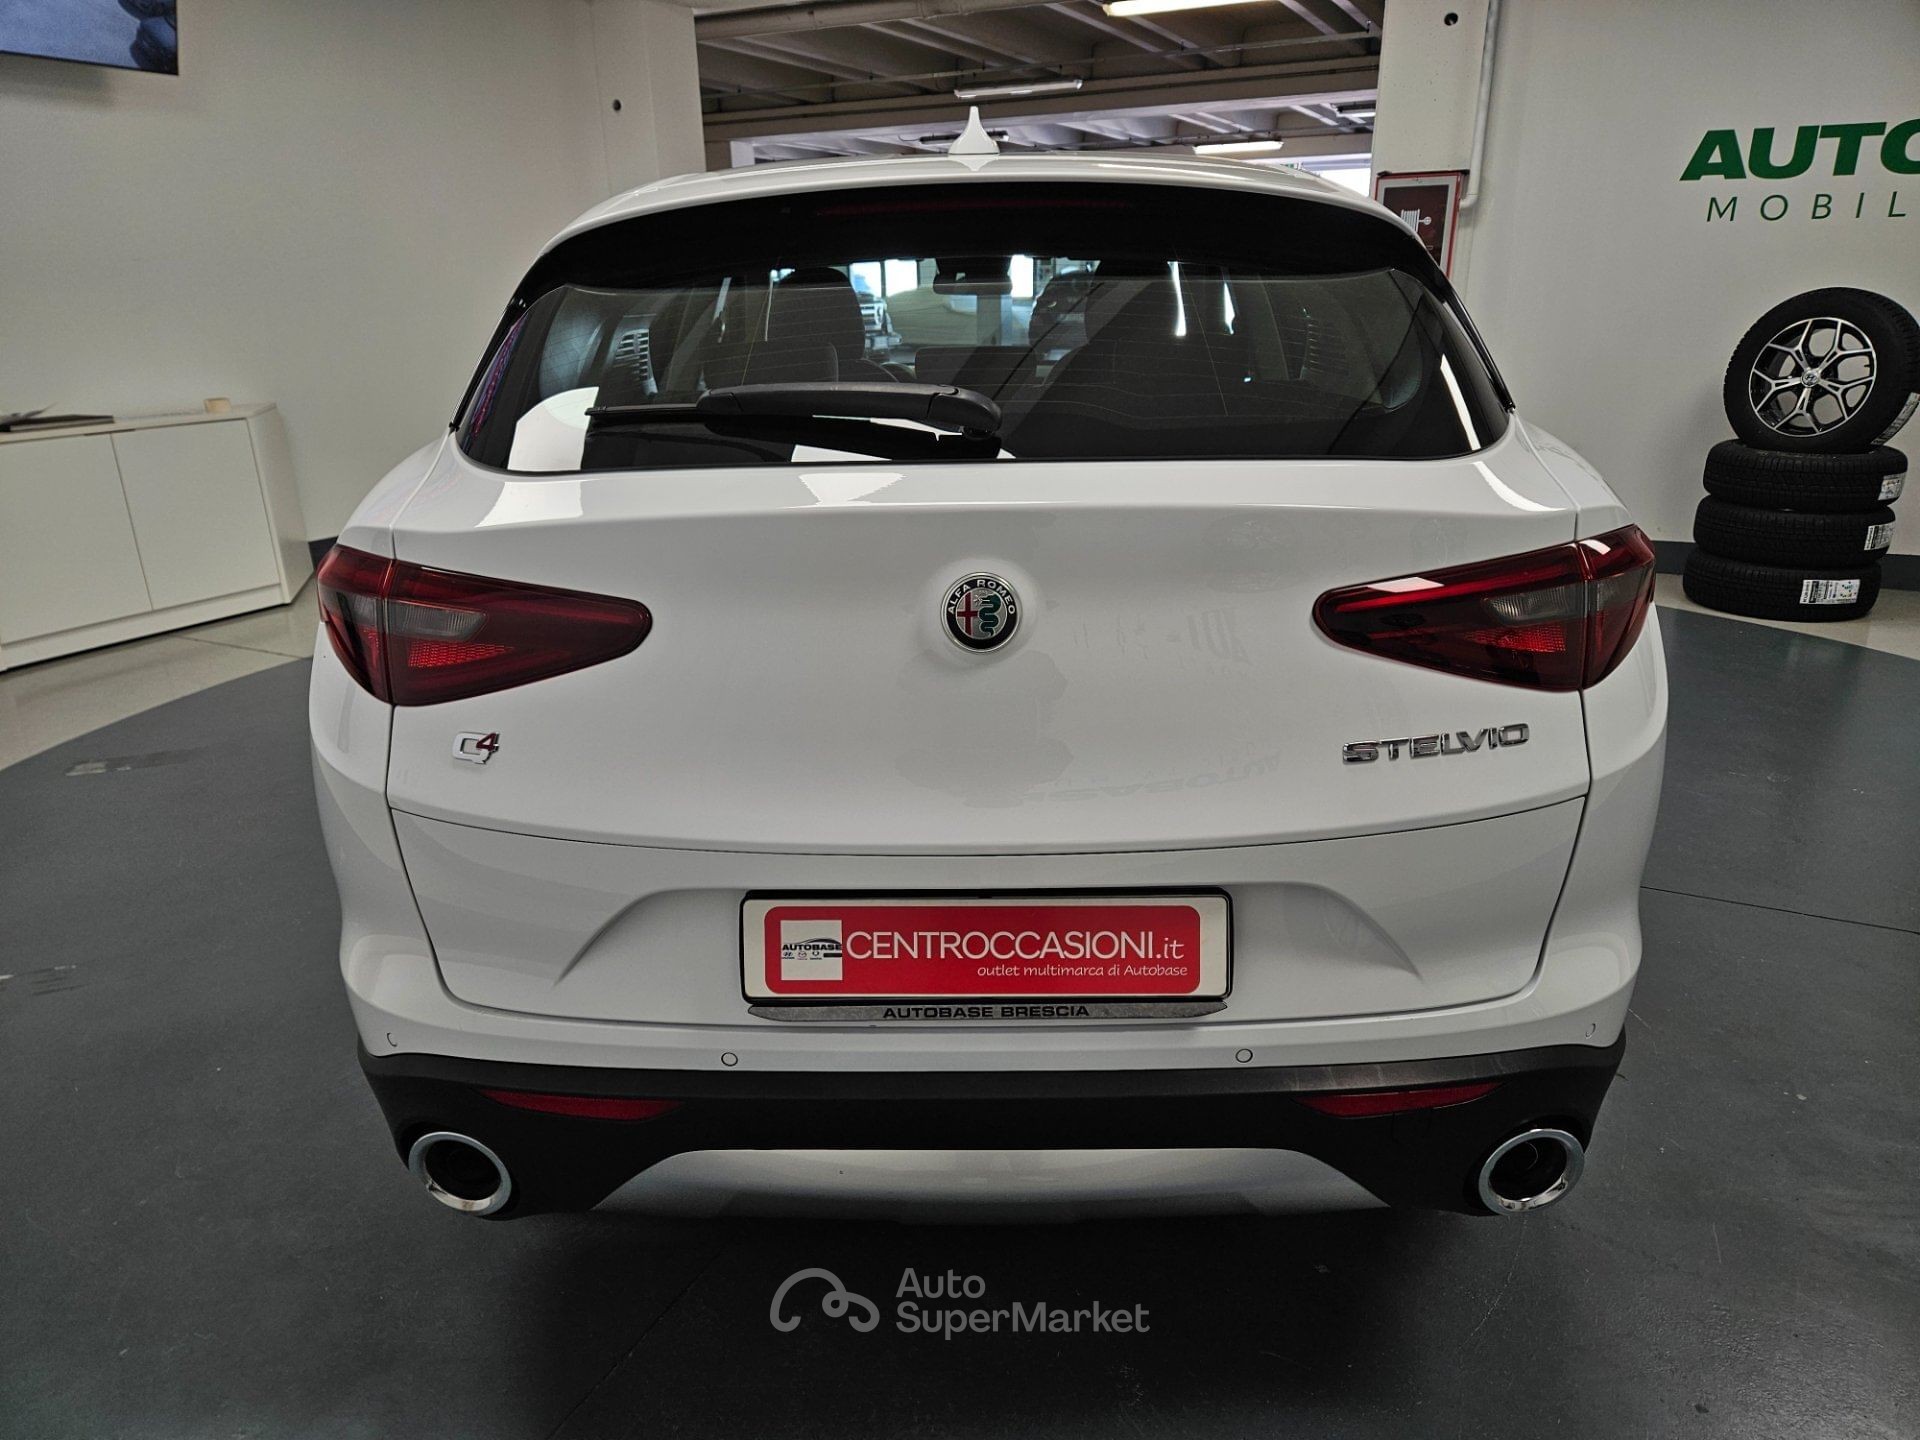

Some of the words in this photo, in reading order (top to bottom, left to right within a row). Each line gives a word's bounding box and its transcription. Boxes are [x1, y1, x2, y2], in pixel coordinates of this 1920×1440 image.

[947, 583, 971, 615] ALFA
[976, 579, 1016, 615] ROMEO
[452, 731, 500, 765] Q4
[1342, 723, 1530, 764] STELVIO
[782, 943, 842, 951] AUTOBASE
[846, 931, 1185, 959] CENTROCCASIONI.it
[977, 964, 1020, 977] outlet
[1023, 964, 1104, 977] multimarca
[1107, 964, 1121, 977] di
[1123, 964, 1188, 977] Autobase
[883, 1007, 994, 1019] AUTOBASE
[1001, 1005, 1090, 1018] BRESCIA
